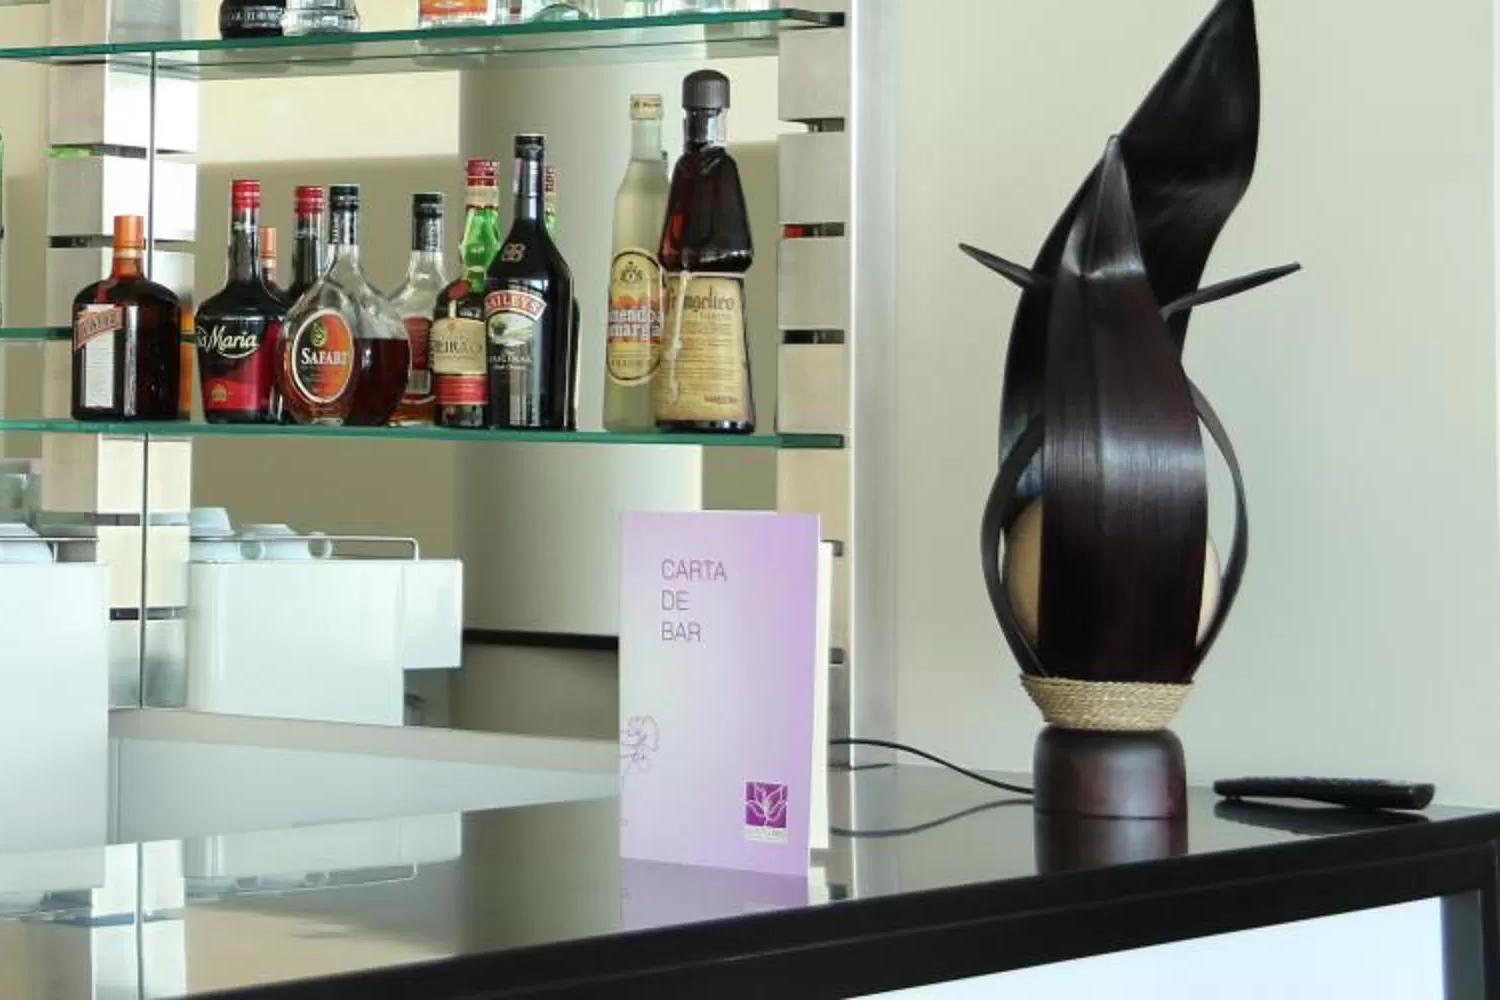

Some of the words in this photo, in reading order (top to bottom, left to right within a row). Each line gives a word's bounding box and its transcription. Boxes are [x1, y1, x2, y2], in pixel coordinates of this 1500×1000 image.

[208, 325, 260, 352] Maria
[300, 347, 347, 365] SAFARI
[660, 559, 728, 583] CARTA
[660, 589, 690, 612] DE
[660, 621, 702, 643] BAR
